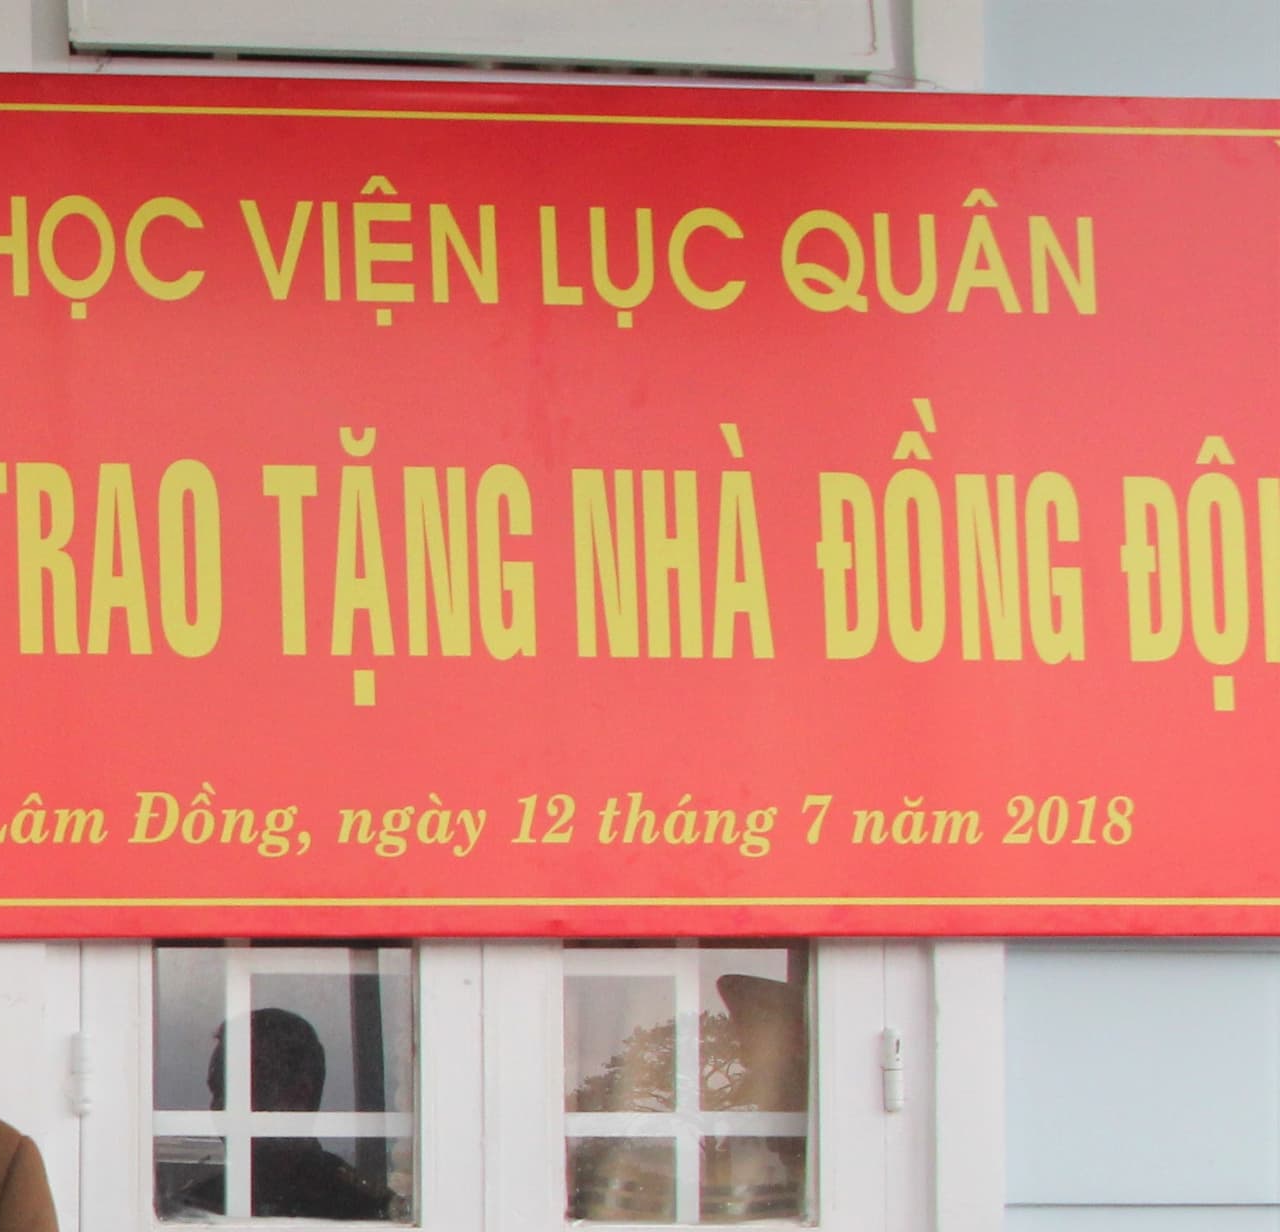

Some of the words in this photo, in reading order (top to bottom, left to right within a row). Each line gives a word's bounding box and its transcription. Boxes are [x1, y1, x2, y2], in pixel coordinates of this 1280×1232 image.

[239, 174, 501, 328] VIỆN
[538, 204, 748, 330] LỤC
[780, 187, 1098, 316] QUÂN
[261, 425, 539, 707] TẶNG
[570, 421, 776, 661] NHÀ
[815, 397, 1088, 666] ĐỒNG
[128, 781, 313, 859] Đồng,
[337, 792, 489, 859] ngày
[511, 792, 577, 845] 12
[597, 790, 780, 859] tháng
[800, 793, 833, 845] 7
[851, 797, 984, 846] năm
[1001, 794, 1136, 847] 2018
